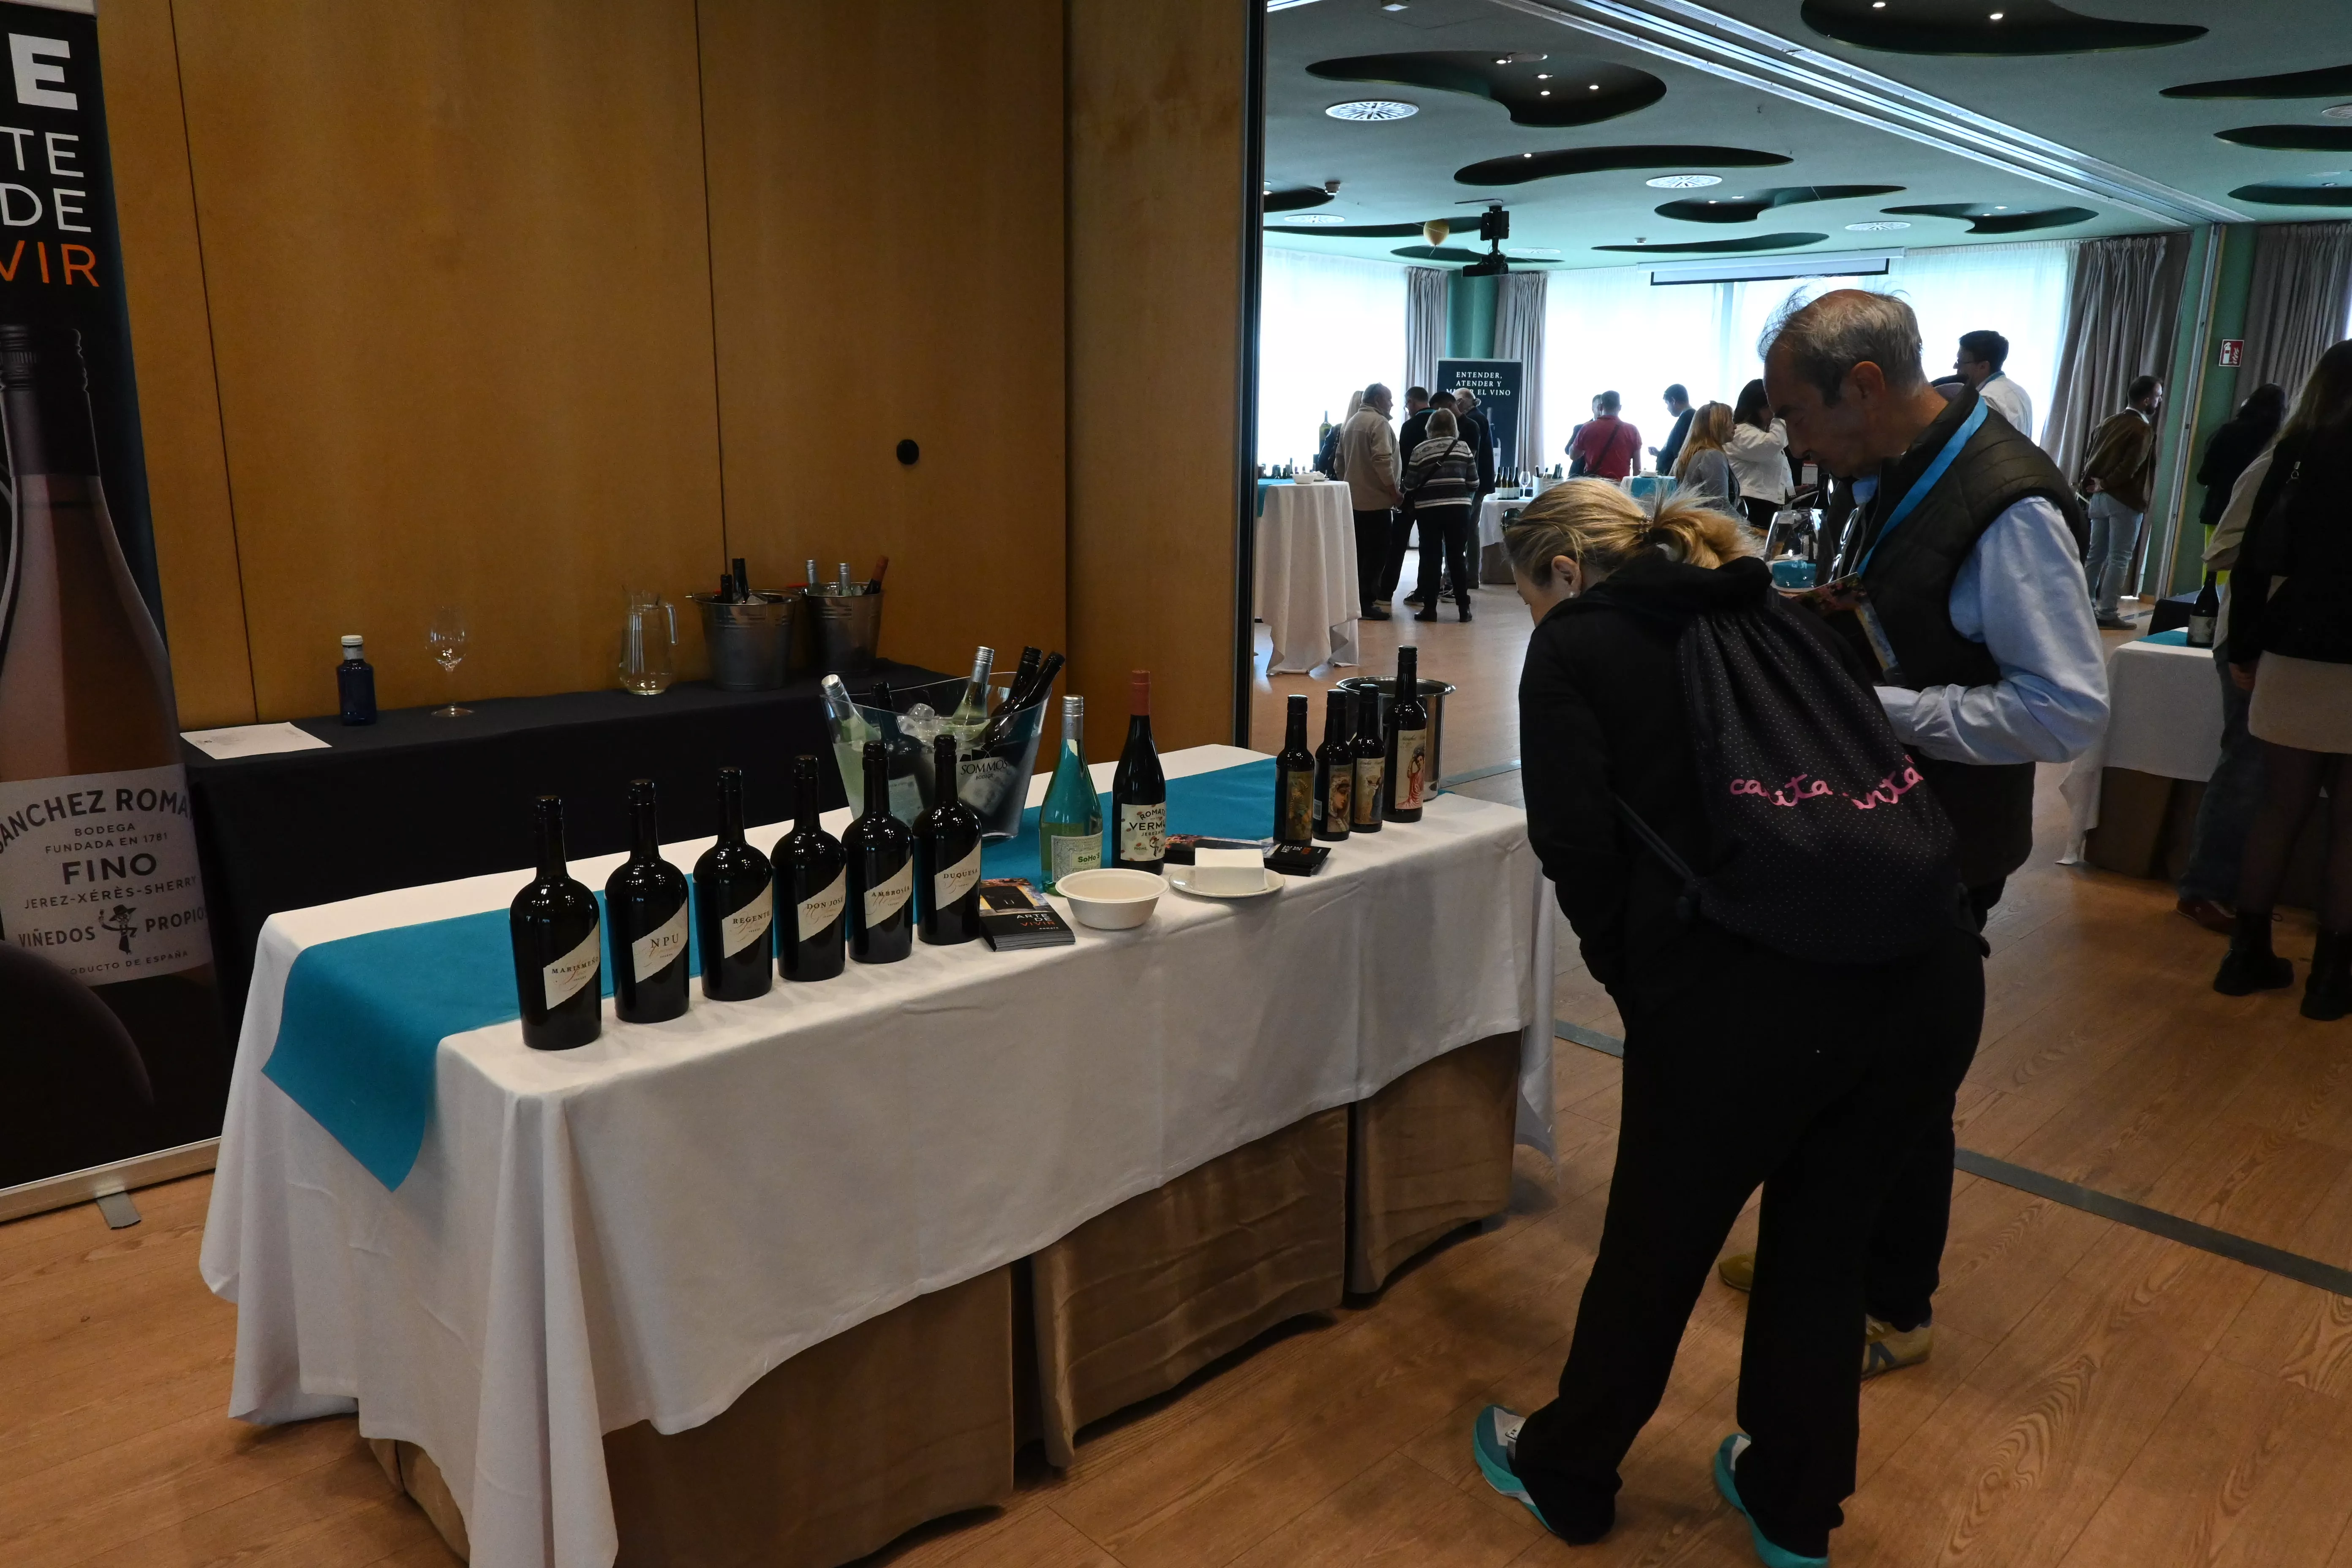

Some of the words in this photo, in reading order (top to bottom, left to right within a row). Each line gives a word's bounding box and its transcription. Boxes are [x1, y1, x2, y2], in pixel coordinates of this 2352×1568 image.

[8, 33, 78, 110] E
[0, 126, 84, 177] TE
[0, 183, 92, 233] DE
[961, 760, 1008, 775] SOMMOS
[116, 789, 193, 820] ROMA
[75, 823, 135, 836] BODEGA
[45, 840, 114, 854] FUNDADA
[120, 837, 138, 847] EN
[143, 832, 167, 843] 1781
[62, 853, 156, 885] FINO
[944, 868, 977, 879] DUQUESA
[24, 876, 196, 909] JEREZ-XÉRÈS-SHERRY
[871, 885, 910, 897] AMBROSÍA
[19, 926, 95, 947] VIÑEDOS
[145, 906, 206, 932] PROPIO
[650, 933, 679, 948] NPU
[70, 962, 120, 975] ODUCTO
[126, 959, 141, 967] DE
[146, 950, 188, 964] ESPAÑA
[552, 956, 599, 974] MARISMEÑO
